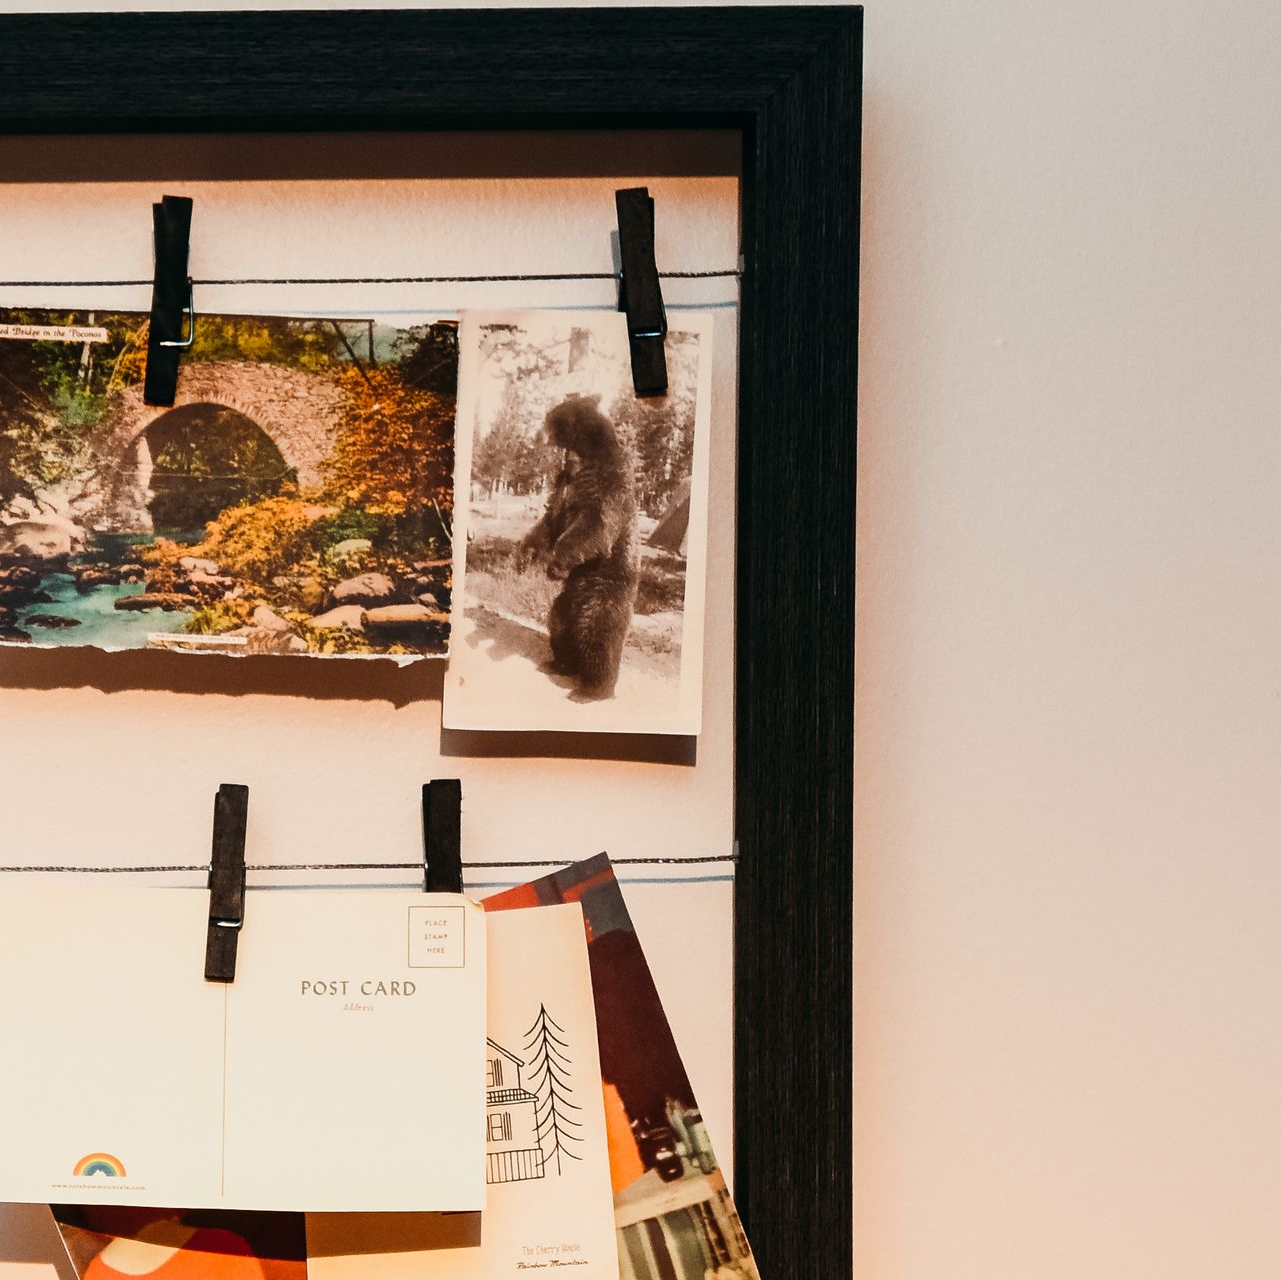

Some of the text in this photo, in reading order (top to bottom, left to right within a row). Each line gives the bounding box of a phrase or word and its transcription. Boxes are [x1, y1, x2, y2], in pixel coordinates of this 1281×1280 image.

[12, 327, 40, 337] Bridge
[53, 329, 66, 337] the
[424, 919, 447, 927] PLACE
[424, 933, 448, 941] STAMP
[301, 980, 416, 996] POST CARD
